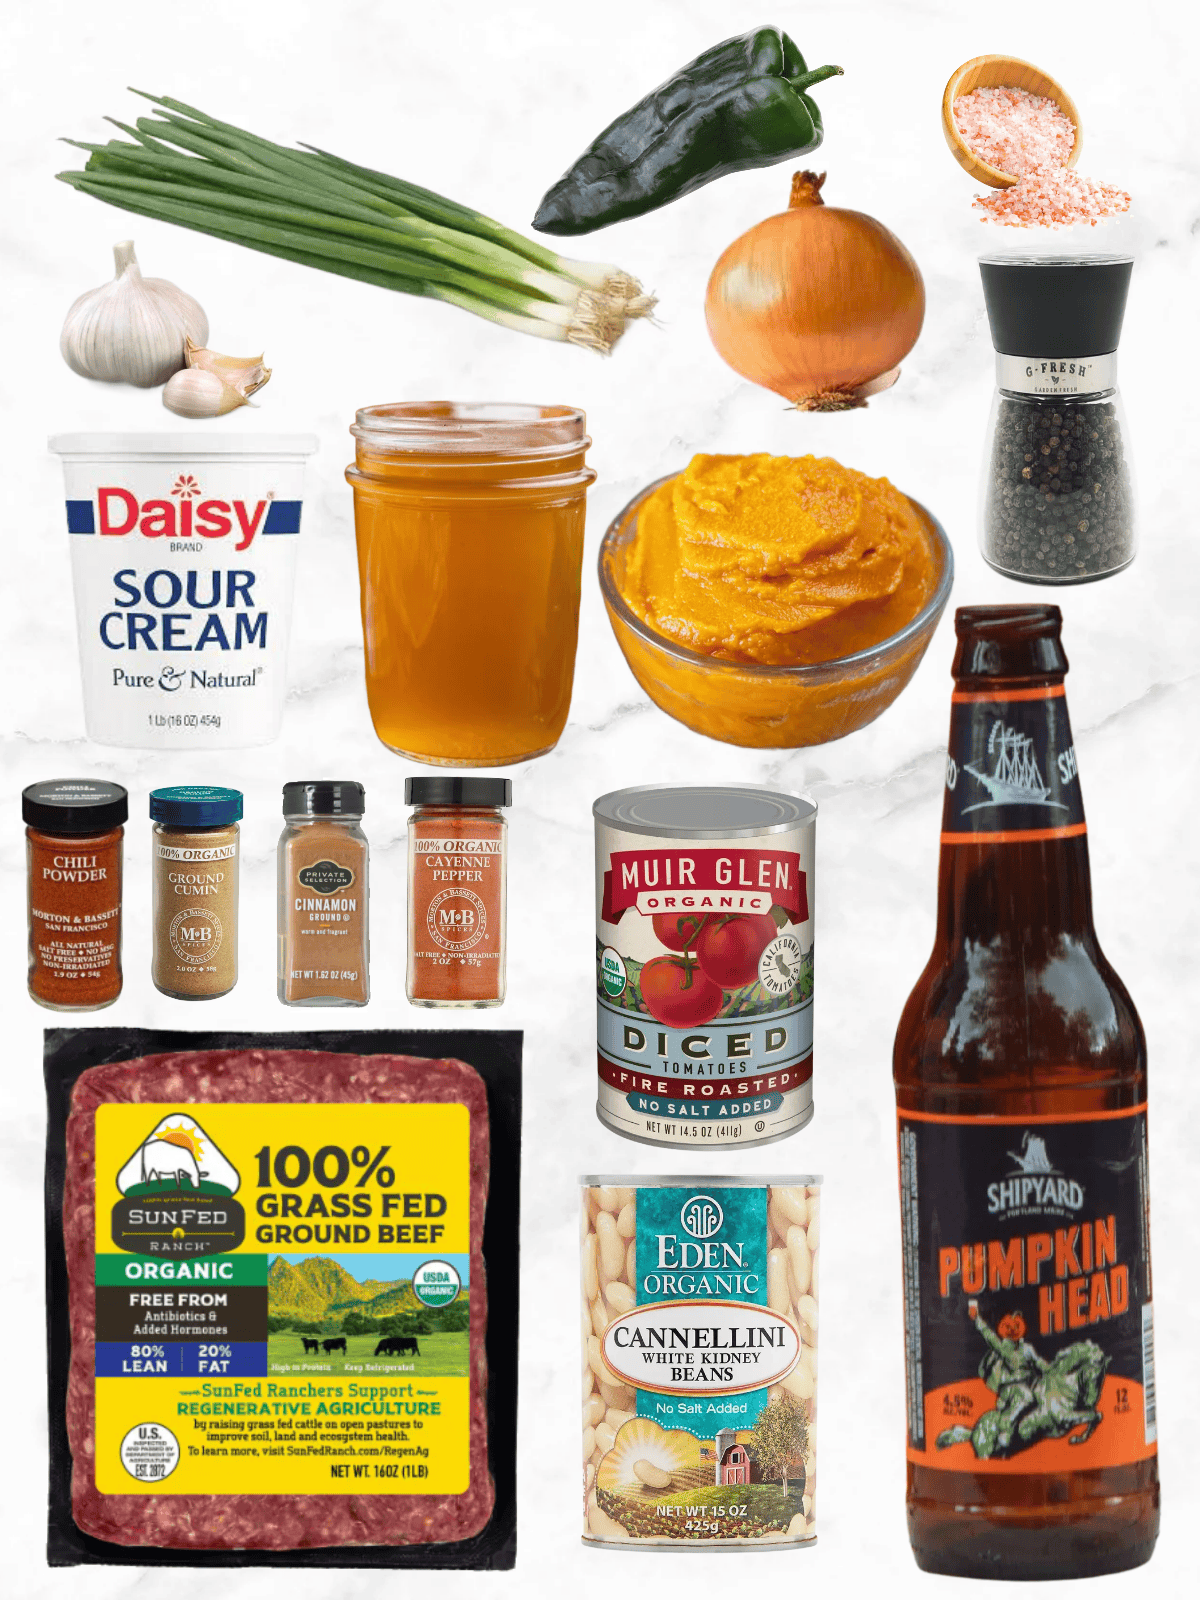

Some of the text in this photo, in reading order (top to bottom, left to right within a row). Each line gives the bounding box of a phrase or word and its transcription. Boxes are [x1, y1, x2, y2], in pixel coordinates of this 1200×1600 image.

[97, 486, 268, 552] Daisy
[170, 542, 202, 552] BRAND
[113, 568, 256, 610] SOUR
[100, 611, 268, 651] CREAM
[113, 666, 256, 692] Pure & Natural
[155, 714, 166, 726] Lb
[168, 714, 182, 728] (16
[184, 714, 198, 728] OZ)
[200, 715, 221, 728] 454g
[182, 845, 235, 860] ORGANIC
[414, 840, 440, 852] 100%
[54, 856, 96, 868] CHILI
[426, 856, 490, 868] CAYENNE
[42, 867, 107, 882] POWDER
[168, 872, 224, 884] GROUND
[432, 870, 483, 881] PEPPER
[622, 858, 789, 890] MUIR GLEN
[174, 884, 218, 895] CUMIN
[295, 898, 356, 912] CINNAMON
[647, 897, 762, 908] ORGANIC
[32, 908, 70, 923] MORTON
[84, 908, 118, 922] BASSETT
[45, 922, 108, 932] SAN FRANCISCO
[39, 944, 55, 954] SALT
[100, 944, 114, 952] MSG
[66, 940, 103, 949] NATURAL
[41, 952, 112, 963] NO PRESERVATIVES
[763, 939, 799, 966] CALIFORNIA
[43, 959, 110, 970] NON-IRRADIATED
[468, 958, 481, 966] 57g
[290, 970, 358, 981] NET WT 1.62 OZ (45g)
[764, 968, 798, 992] TOMATOES
[623, 1025, 788, 1060] DICED
[663, 1061, 747, 1075] TOMATOES
[620, 1072, 790, 1096] FIRE ROASTED
[639, 1098, 772, 1116] NO SALT ADDED
[646, 1120, 742, 1138] NET WT 14.5 OZ (411g)
[254, 1145, 396, 1188] 100%
[987, 1177, 1084, 1214] SHIPYARD
[255, 1193, 447, 1218] GRASS FED
[255, 1224, 445, 1244] GROUND BEEF
[150, 1242, 204, 1251] RANCH
[655, 1234, 744, 1269] EDEN
[939, 1214, 1117, 1298] PUMPKIN
[125, 1262, 233, 1280] ORGANIC
[423, 1272, 450, 1283] USDA
[420, 1286, 453, 1295] ORGANIC
[644, 1274, 759, 1294] ORGANIC
[129, 1293, 228, 1306] FREE FROM
[1039, 1264, 1129, 1336] HEAD
[144, 1310, 217, 1321] Antibiotics &
[133, 1324, 228, 1335] Added Hormones
[613, 1326, 786, 1348] CANNELLINI
[130, 1344, 232, 1357] 80% 20%
[642, 1352, 761, 1364] WHITE KIDNEY
[122, 1360, 230, 1373] LEAN FAT
[671, 1367, 733, 1382] BEANS
[202, 1382, 414, 1401] SunFed Ranchers Support
[1116, 1388, 1128, 1402] 12
[177, 1402, 441, 1415] REGENERATIVE AGRICULTURE
[656, 1403, 747, 1414] No Salt Added
[194, 1418, 206, 1432] by
[209, 1419, 245, 1431] raising
[247, 1421, 274, 1431] grass
[277, 1418, 293, 1429] fed
[295, 1418, 322, 1429] cattle
[340, 1421, 364, 1431] open
[367, 1419, 411, 1431] pastures
[413, 1420, 424, 1429] to
[139, 1428, 162, 1440] U.S.
[206, 1430, 410, 1444] improve soil, land and ecosystem health.
[188, 1445, 429, 1458] To learn more, visit SunFedRanch.com/RegenAg
[331, 1465, 429, 1479] NET WT. 16OZ (1LB)
[656, 1505, 748, 1516] NET WT 15 OZ
[685, 1520, 719, 1534] 425g
